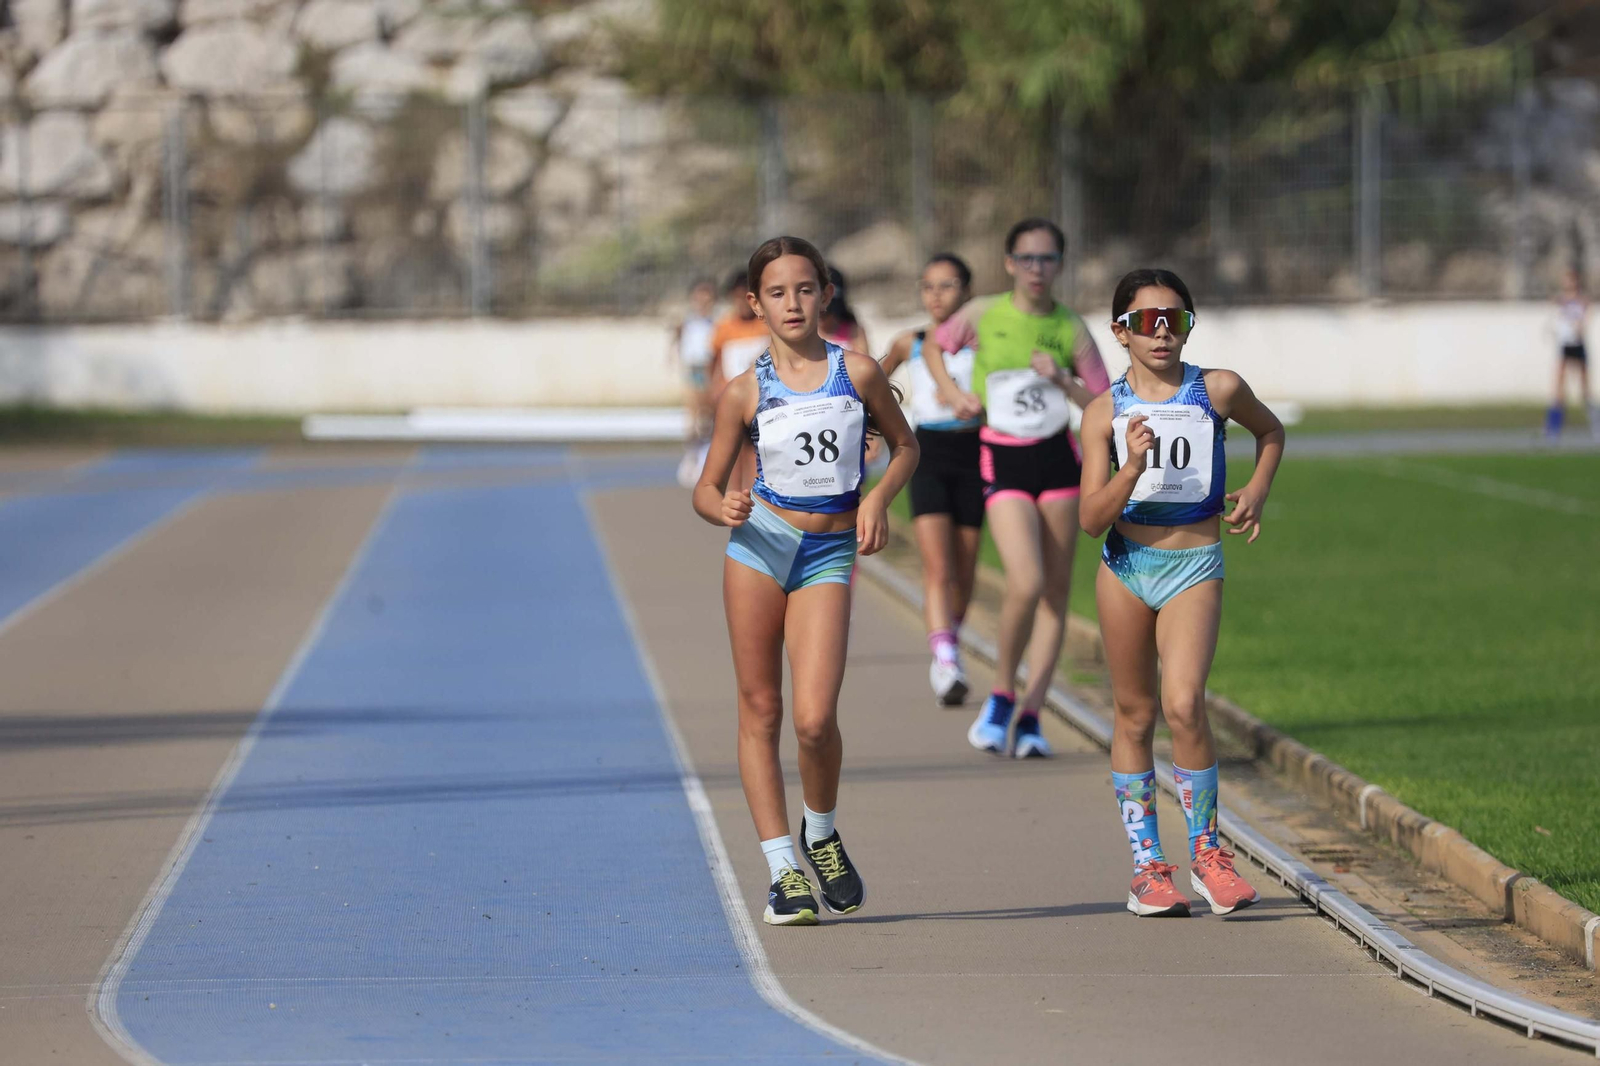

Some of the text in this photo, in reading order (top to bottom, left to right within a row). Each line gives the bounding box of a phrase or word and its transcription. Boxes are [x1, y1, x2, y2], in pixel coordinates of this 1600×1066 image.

[1014, 387, 1046, 416] 58
[794, 429, 840, 466] 38
[1148, 436, 1191, 470] 10
[808, 475, 835, 485] docunova
[1156, 482, 1183, 491] docunova
[1183, 789, 1192, 809] NEW
